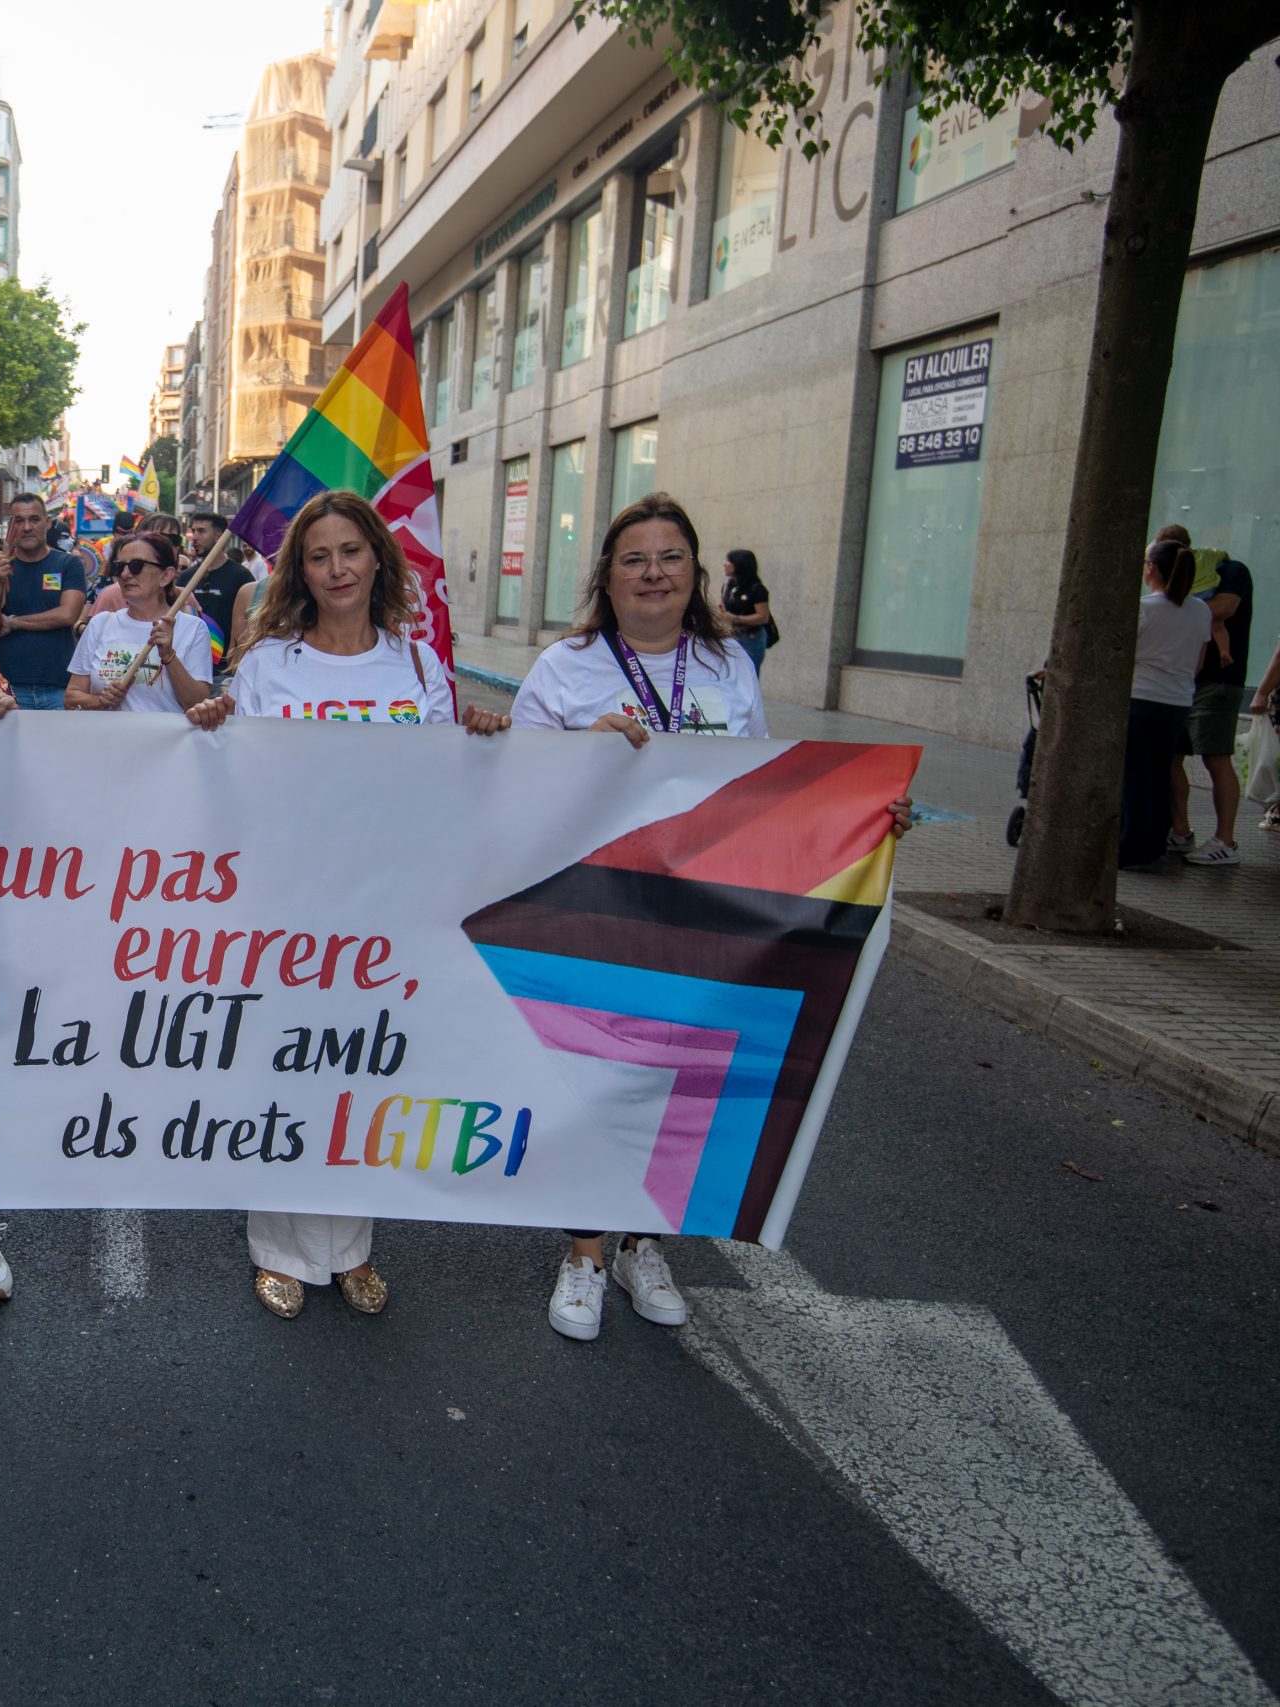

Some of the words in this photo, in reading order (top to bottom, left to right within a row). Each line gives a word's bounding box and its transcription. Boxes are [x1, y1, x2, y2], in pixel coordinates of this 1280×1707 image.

[906, 358, 924, 384] EN
[924, 343, 990, 379] ALQUILER
[907, 397, 947, 417] FINCASA
[899, 435, 916, 454] 96
[917, 432, 942, 451] 546
[945, 430, 962, 448] 33
[964, 427, 980, 445] 10
[627, 656, 641, 676] UGT
[676, 667, 685, 686] UGT
[647, 704, 661, 725] UGT
[110, 846, 241, 922] pas
[113, 926, 418, 1000] enrrere,
[13, 986, 99, 1067] La
[120, 990, 263, 1072] UGT
[272, 1009, 408, 1076] amb
[61, 1092, 139, 1159] els
[162, 1099, 306, 1163] drets
[325, 1091, 532, 1176] LGTBI
